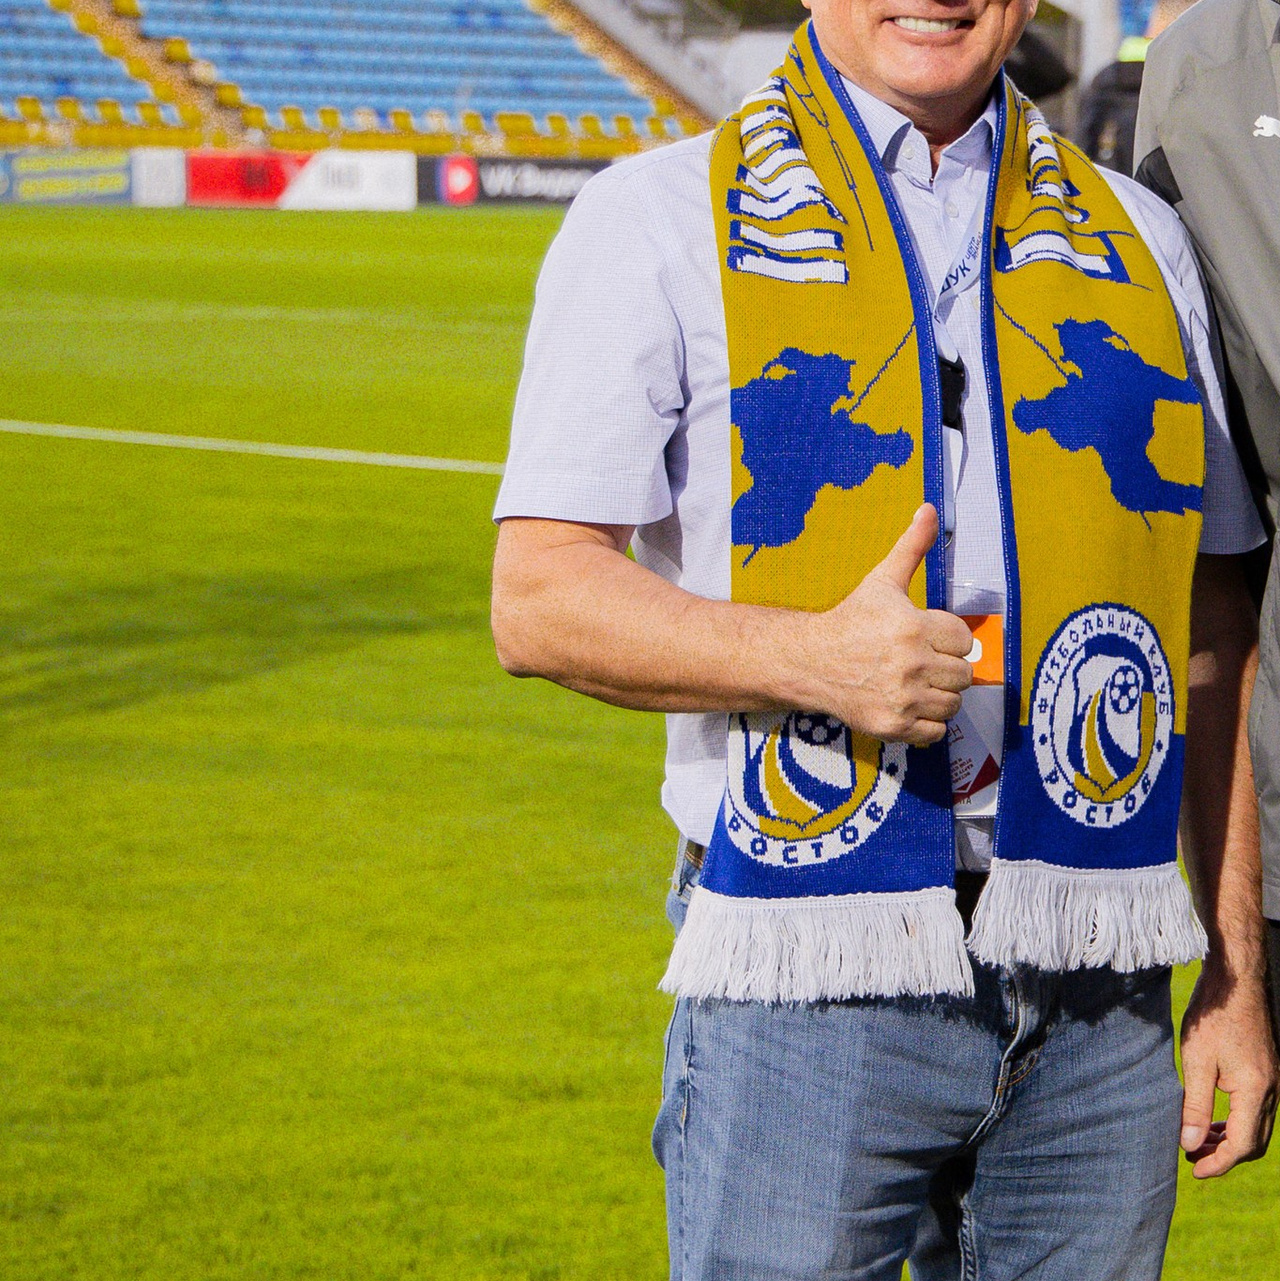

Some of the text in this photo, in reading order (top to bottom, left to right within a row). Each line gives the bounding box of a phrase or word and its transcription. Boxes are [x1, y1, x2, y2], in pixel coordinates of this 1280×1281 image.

[1147, 643, 1169, 715] КЛУБ
[1044, 766, 1151, 824] РОСТОВ
[728, 801, 884, 864] РОСТОВ
